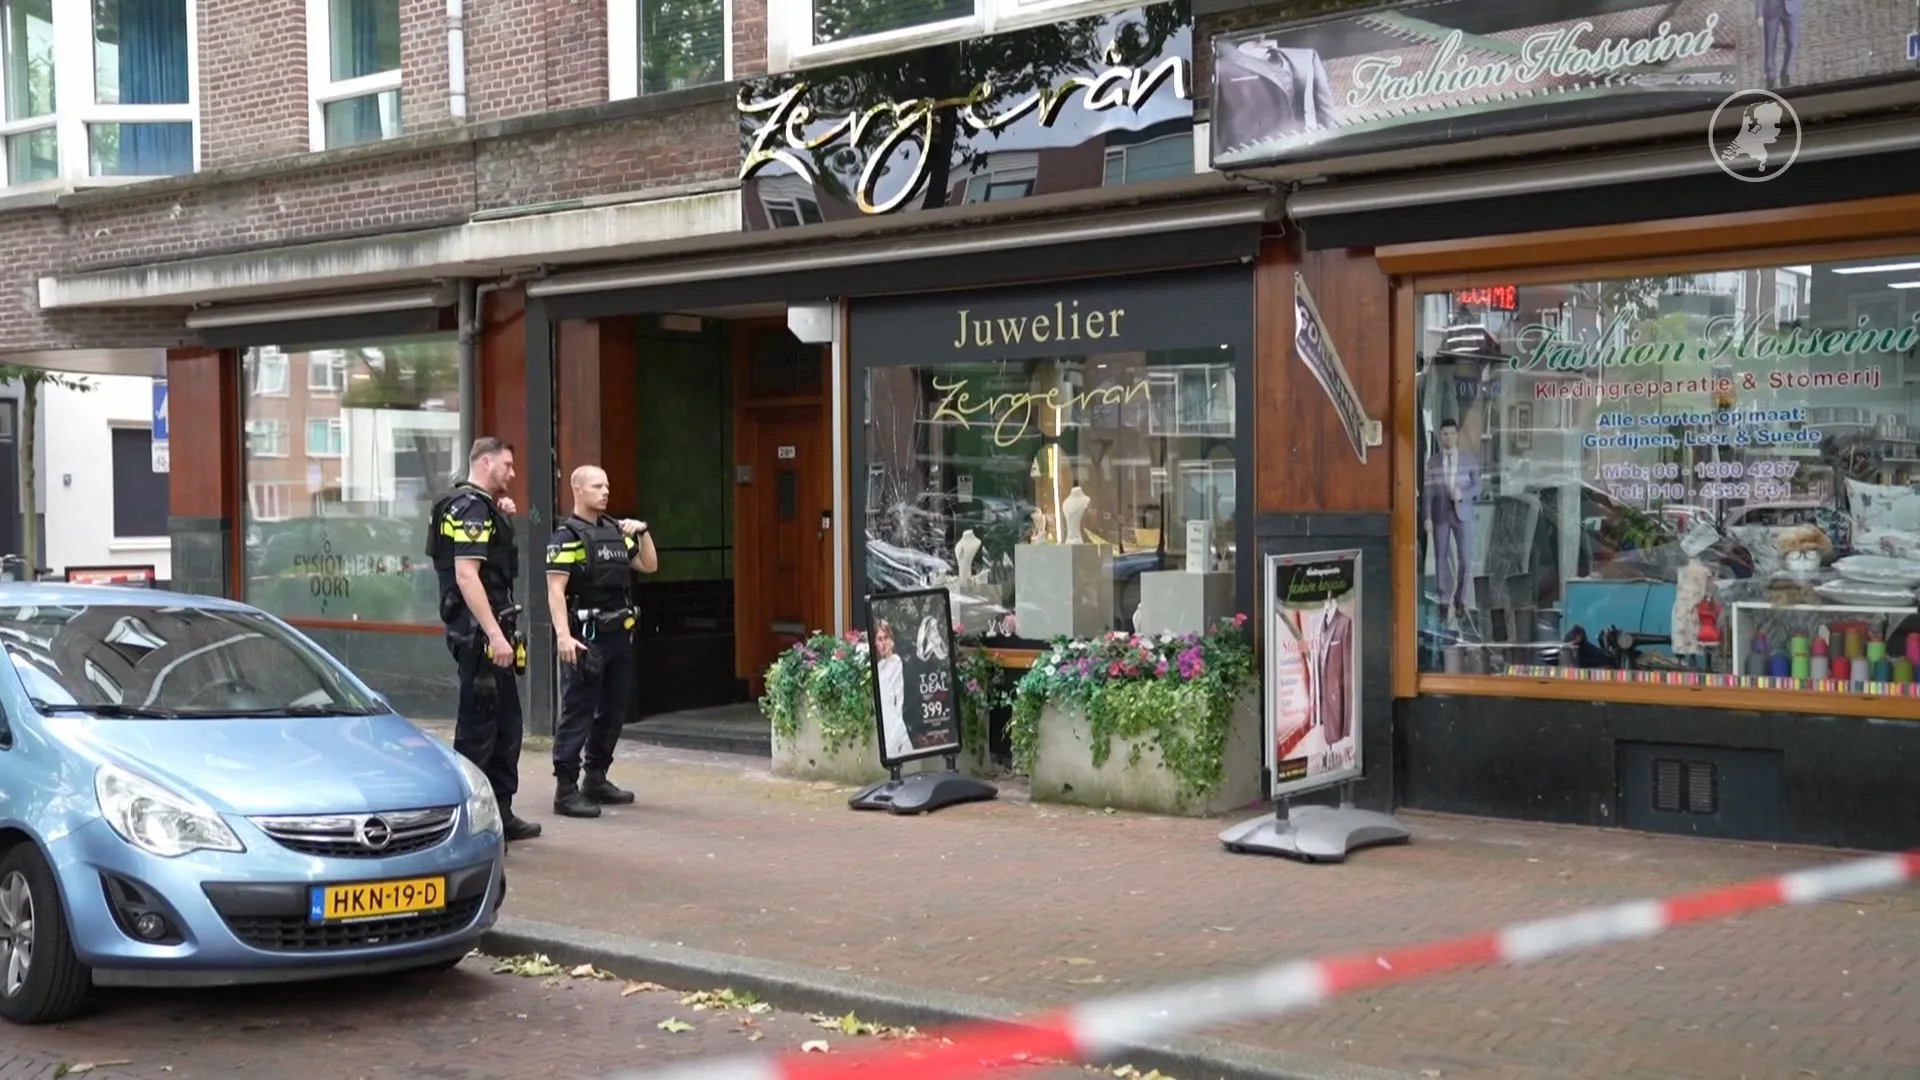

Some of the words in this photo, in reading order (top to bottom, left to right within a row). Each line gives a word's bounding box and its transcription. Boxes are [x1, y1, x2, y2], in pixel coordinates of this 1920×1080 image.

[1346, 29, 1511, 109] Fashion
[1515, 13, 1721, 82] Hosseini
[737, 57, 1190, 214] Zergeran
[954, 300, 1125, 348] Juwelier
[1510, 303, 1686, 372] Fashion
[1698, 308, 1920, 364] Hosseini
[1535, 377, 1734, 401] Kledingreparatie
[1742, 372, 1757, 391] &
[1769, 367, 1882, 389] Stomerij
[932, 376, 1151, 447] Zergeran
[1599, 413, 1633, 427] Alle
[1639, 412, 1718, 426] soorten
[1719, 411, 1743, 426] op
[1749, 407, 1806, 422] maat:
[1685, 431, 1729, 446] Leer
[1736, 429, 1750, 445] &
[1757, 428, 1821, 443] Suede
[1653, 462, 1678, 479] 06
[1694, 461, 1743, 478] 1900
[1747, 461, 1799, 477] 4267
[1648, 483, 1684, 499] 010
[1700, 482, 1750, 499] 4532
[919, 671, 947, 683] TOP
[920, 681, 949, 694] DEAL
[334, 883, 437, 913] HKN-19-D
